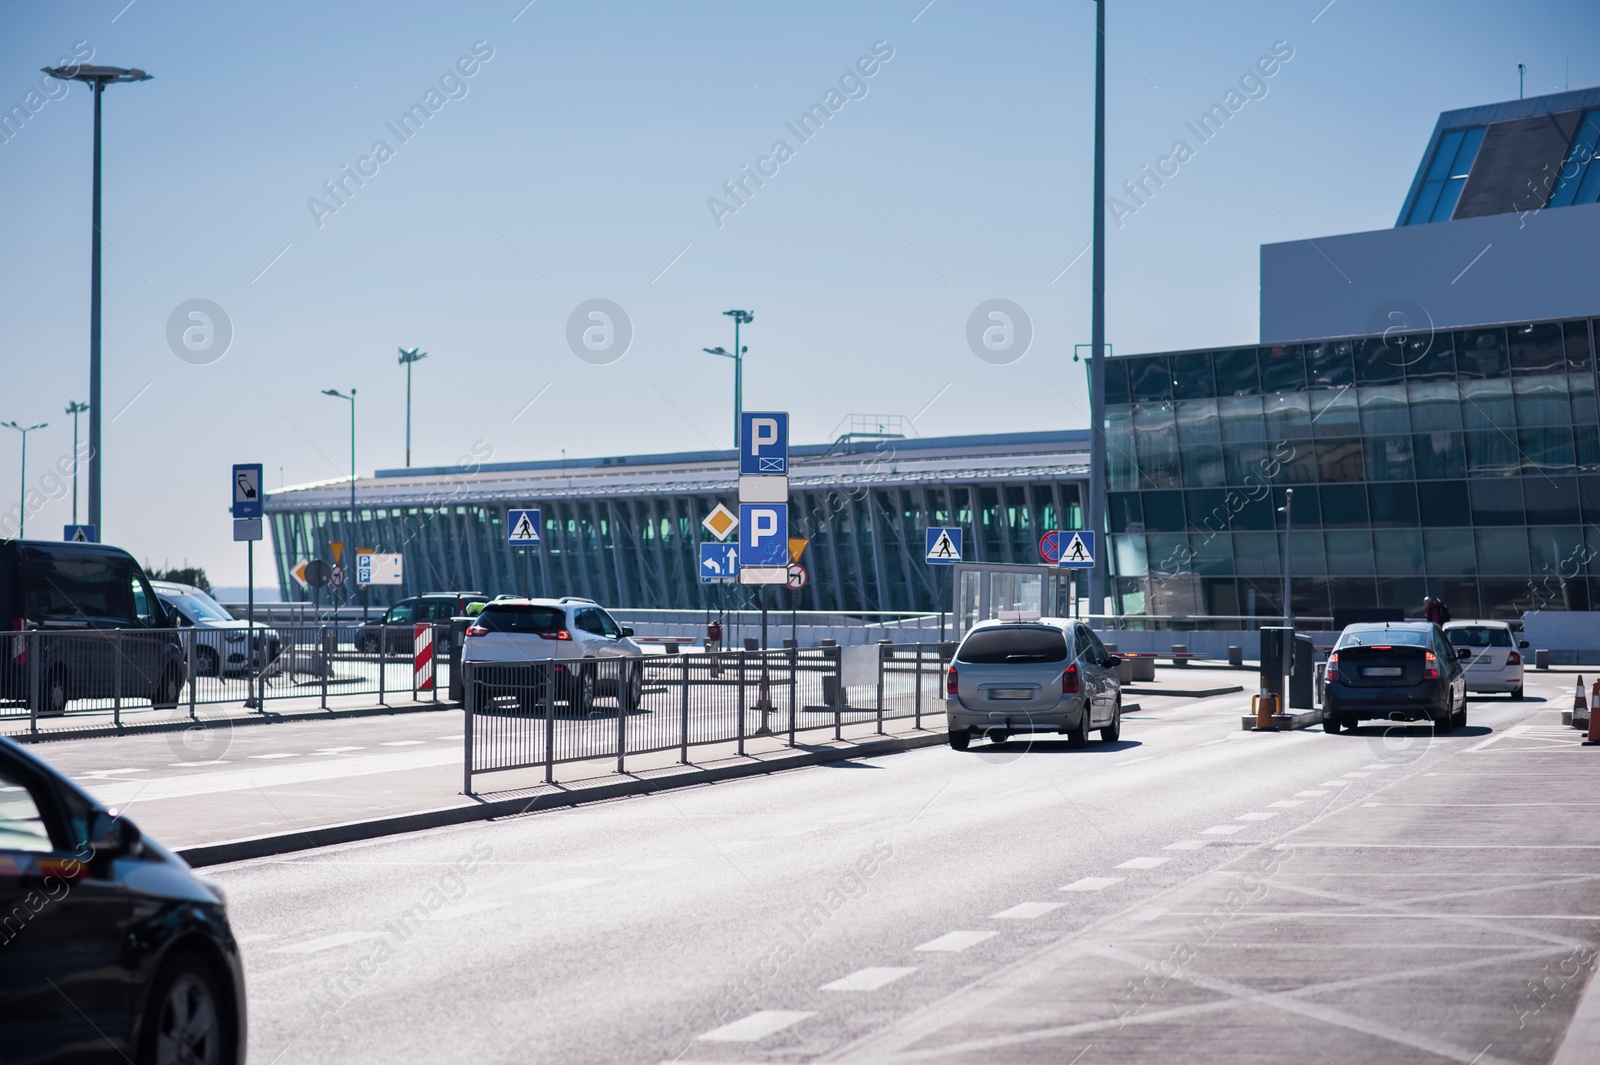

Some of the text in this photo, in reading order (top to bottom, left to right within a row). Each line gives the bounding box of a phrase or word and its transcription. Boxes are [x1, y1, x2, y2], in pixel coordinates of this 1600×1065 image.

[752, 418, 778, 456] P
[751, 509, 778, 547] P
[361, 557, 369, 566] P
[361, 573, 369, 581] P
